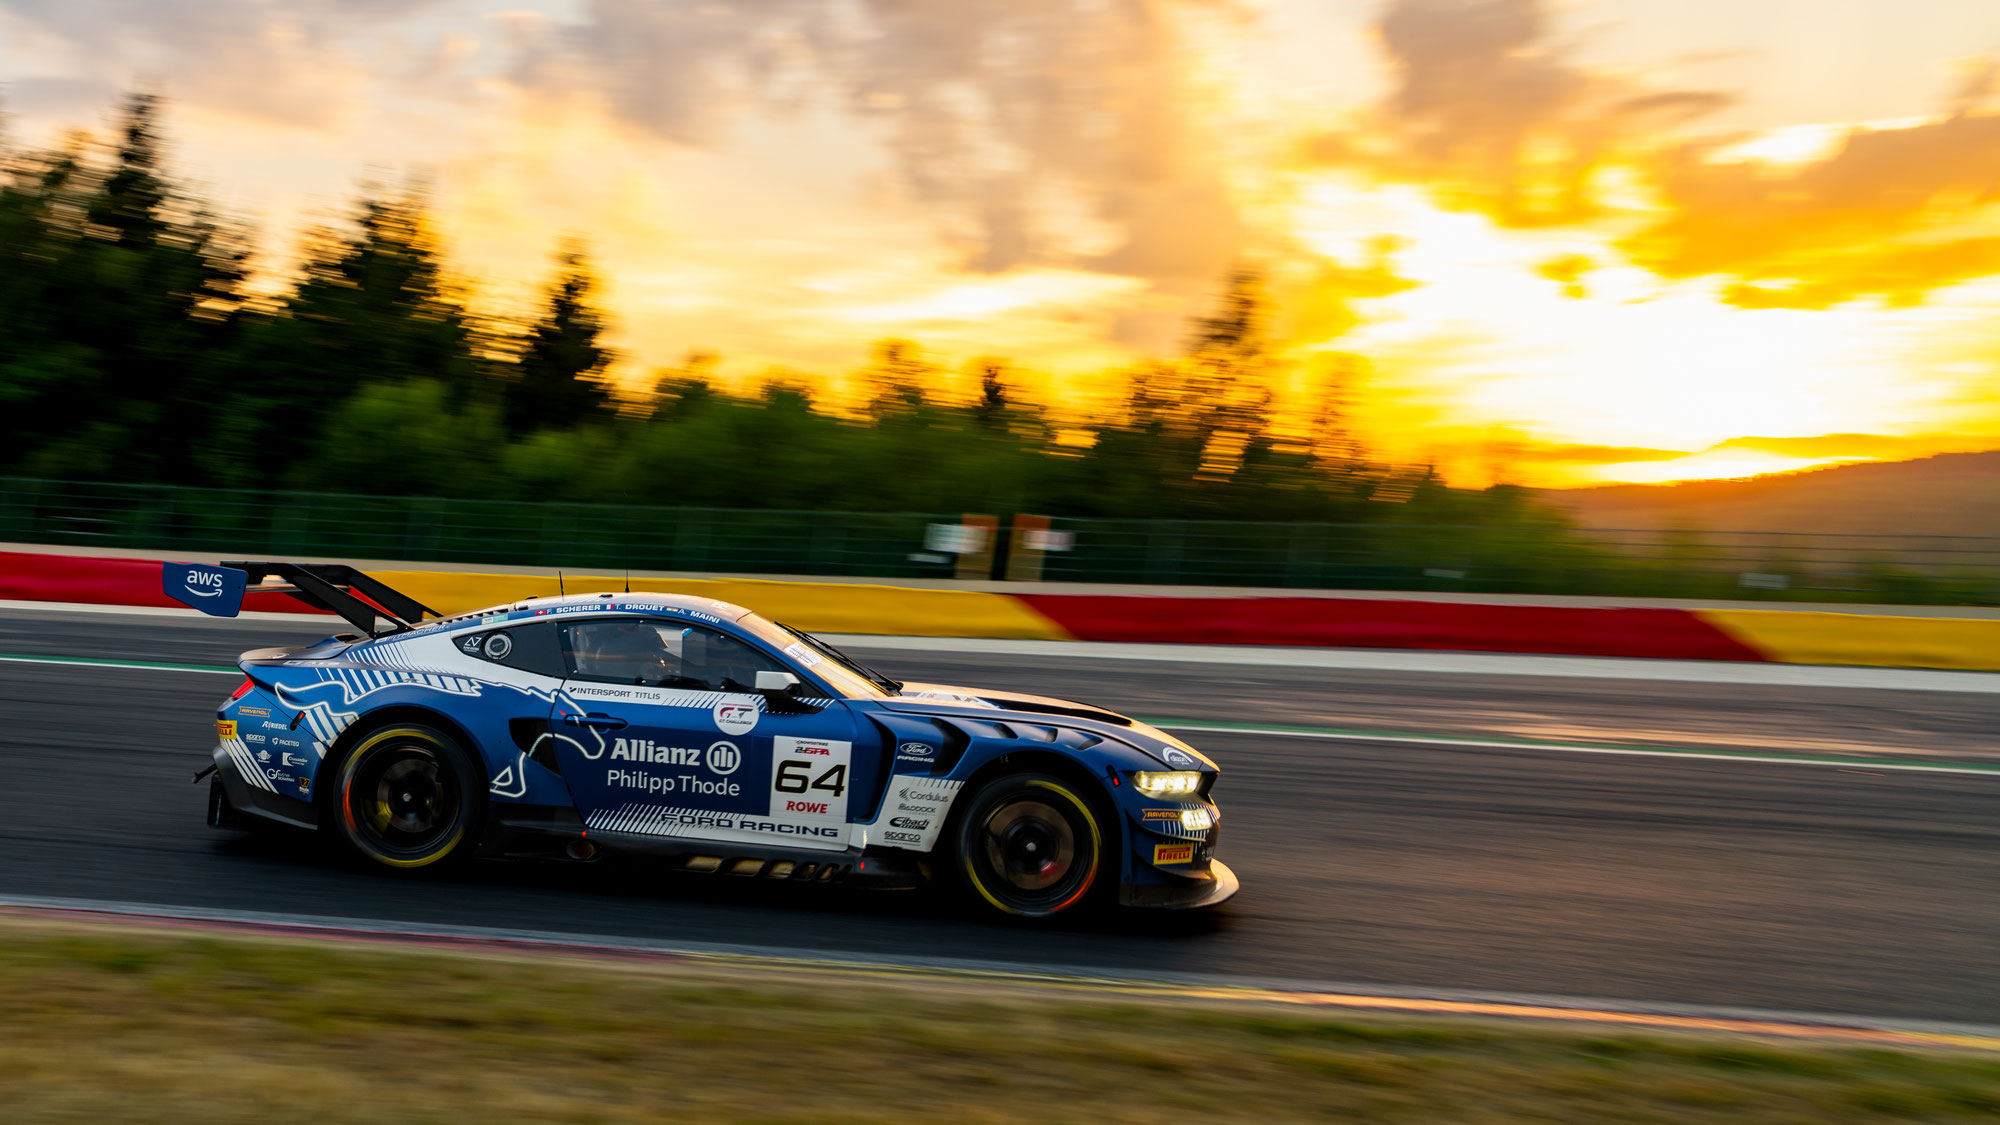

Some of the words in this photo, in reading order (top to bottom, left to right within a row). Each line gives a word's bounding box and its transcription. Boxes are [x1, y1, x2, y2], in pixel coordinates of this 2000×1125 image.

[186, 571, 223, 588] aws
[556, 604, 600, 614] SCHERER
[690, 610, 720, 624] MAINI
[577, 687, 631, 698] INTERSPORT
[635, 691, 661, 700] TITLIS
[610, 738, 701, 766] Allianz
[897, 755, 935, 763] RACING
[607, 769, 675, 794] Philipp
[678, 775, 741, 796] Thode
[774, 759, 847, 798] 64
[909, 791, 949, 802] Cordulus
[786, 800, 828, 814] ROWE
[660, 812, 733, 829] FORD
[739, 819, 839, 838] RACING
[889, 816, 930, 830] Eibach
[884, 831, 921, 841] sparco
[1157, 847, 1191, 860] PIRELLI
